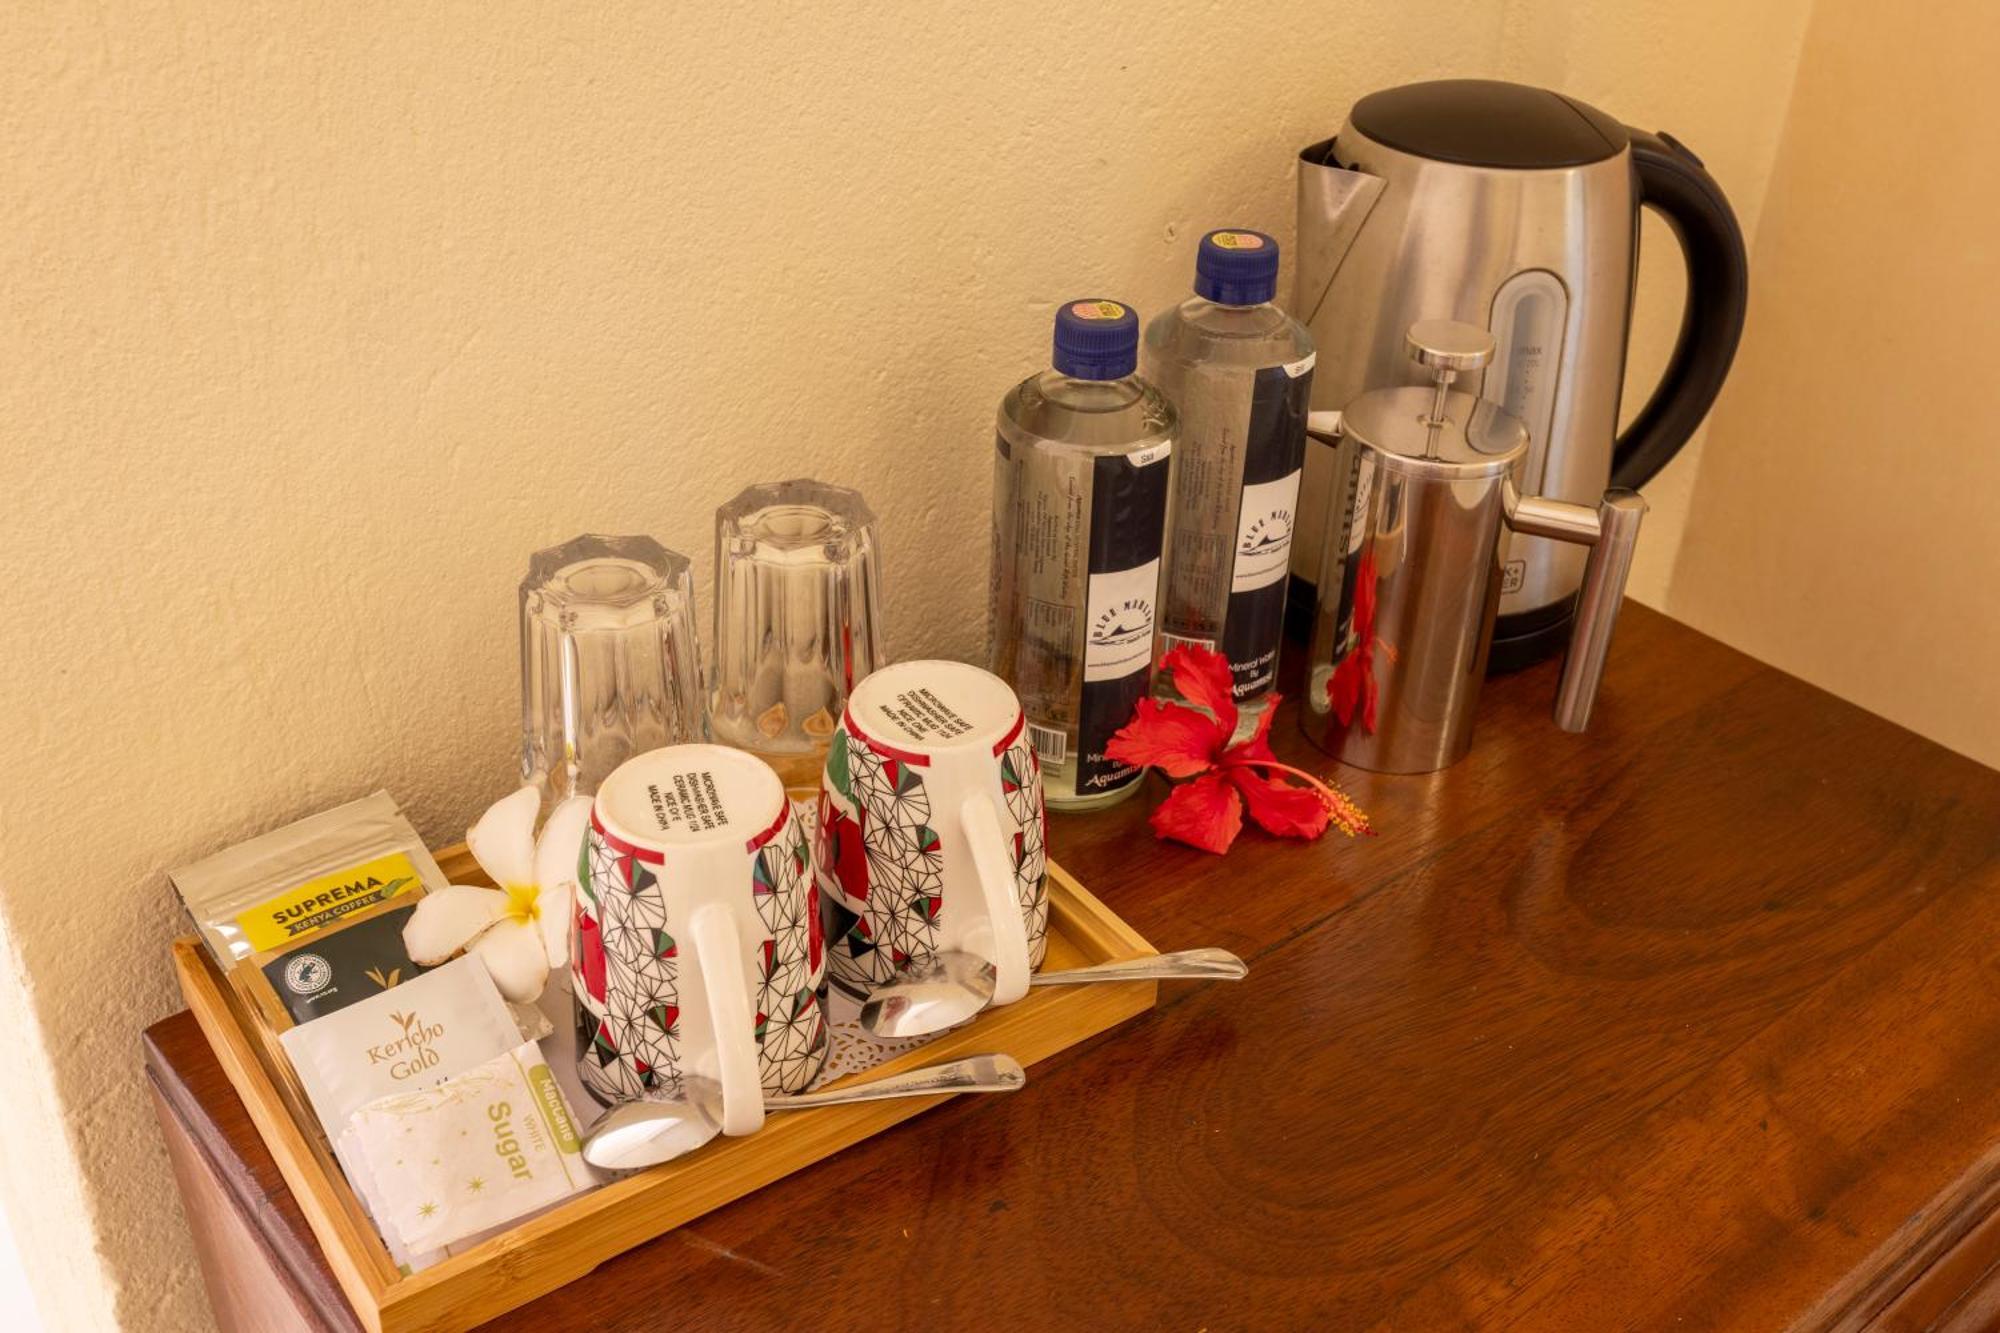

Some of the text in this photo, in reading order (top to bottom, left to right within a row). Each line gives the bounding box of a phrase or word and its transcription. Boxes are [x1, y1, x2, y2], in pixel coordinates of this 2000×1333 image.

[1093, 608, 1117, 638] BLUE
[880, 705, 900, 721] MADE
[903, 727, 925, 740] CHINA
[897, 694, 925, 717] CERAMIC
[921, 717, 940, 730] MUG
[907, 689, 964, 735] DISHWASHER SAFE
[953, 718, 974, 730] SAFE
[648, 785, 670, 831] MADE IN CHINA
[664, 792, 677, 808] NICE
[673, 775, 690, 804] CERAMIC
[683, 804, 696, 819] MUG
[686, 772, 715, 830] DISHWASHER SAFE
[701, 771, 729, 826] MICROWAVE SAFE
[272, 876, 383, 924] SUPREMA
[294, 894, 377, 932] KENYA COFFEE
[365, 1019, 444, 1065] Kericho
[390, 1046, 440, 1081] Gold
[487, 1101, 534, 1180] Sugar
[523, 1113, 546, 1153] WHITE
